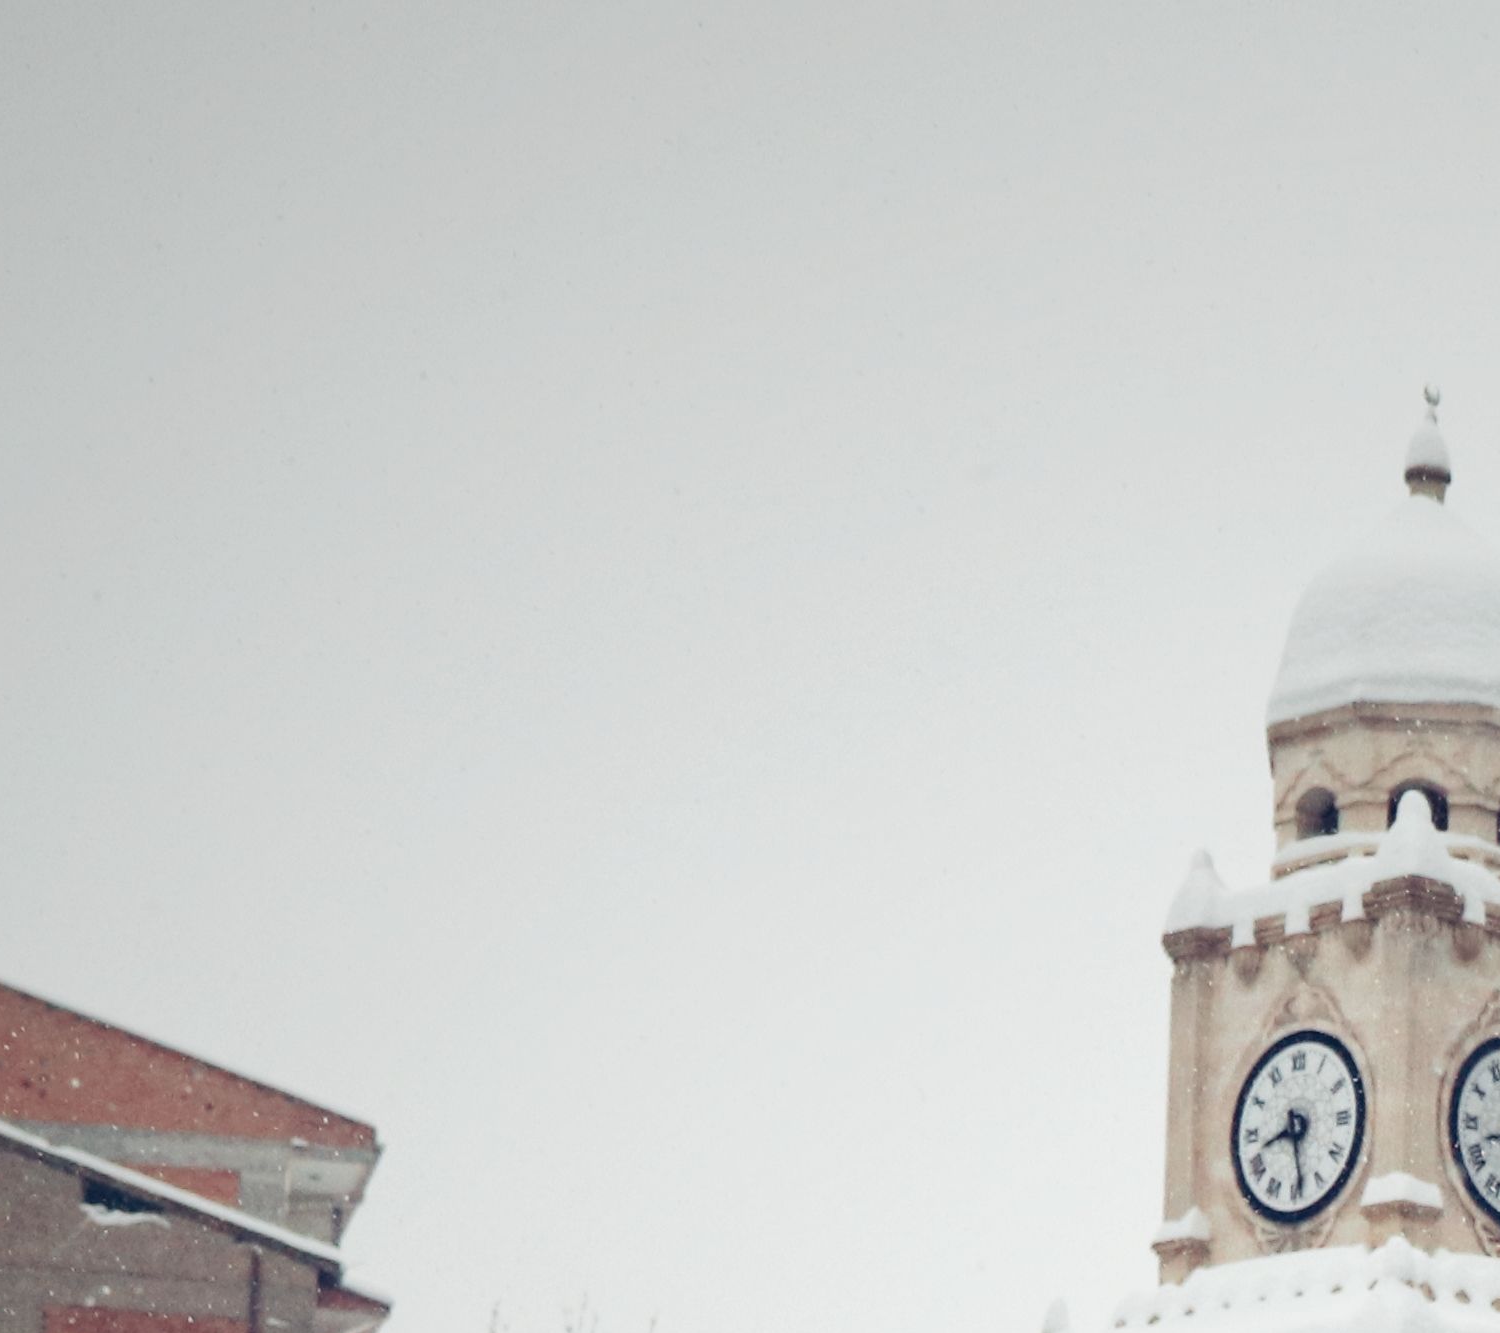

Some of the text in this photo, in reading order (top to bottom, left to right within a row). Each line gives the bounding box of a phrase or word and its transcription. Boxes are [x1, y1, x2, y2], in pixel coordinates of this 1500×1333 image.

[1292, 1052, 1306, 1071] XII
[1268, 1067, 1282, 1087] XI
[1473, 1083, 1486, 1097] X
[1253, 1097, 1265, 1110] X
[1336, 1110, 1349, 1126] III
[1465, 1113, 1478, 1130] IX
[1246, 1128, 1258, 1143] IX
[1328, 1142, 1343, 1163] IV
[1314, 1171, 1324, 1188] V
